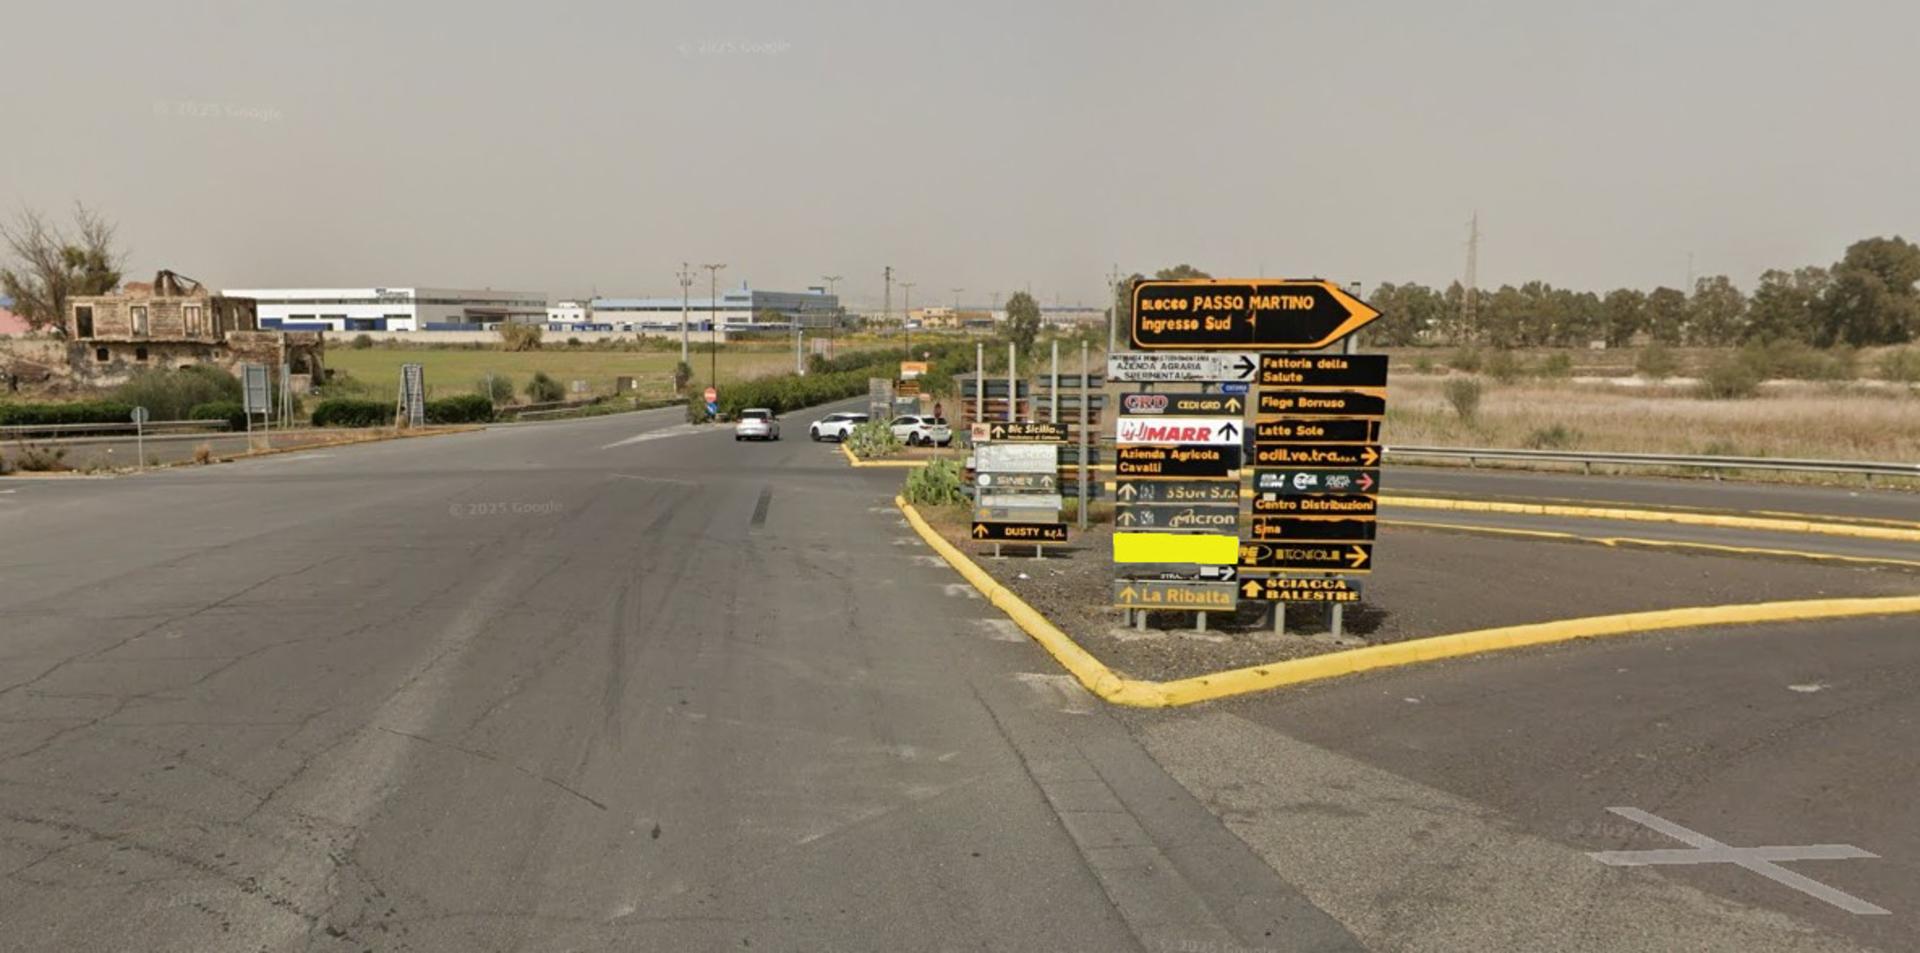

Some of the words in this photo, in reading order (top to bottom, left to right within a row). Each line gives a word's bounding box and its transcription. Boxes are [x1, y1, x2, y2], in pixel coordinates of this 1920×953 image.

[1193, 296, 1243, 311] PASSO
[1250, 296, 1315, 310] MARTINO
[1142, 315, 1199, 334] ingresso
[1205, 315, 1231, 330] Sud
[1117, 362, 1156, 370] AZIENDA
[1161, 362, 1201, 370] AGRARIA
[1263, 358, 1312, 369] Fattoria
[1317, 358, 1348, 369] della
[1263, 372, 1303, 382] Salute
[1147, 427, 1212, 441] MARR
[1259, 426, 1291, 436] Latte
[1296, 426, 1324, 436] Sole
[1120, 450, 1165, 459] Azienda
[1171, 450, 1219, 461] Agricola
[1120, 462, 1161, 472] Cavalli
[1255, 500, 1296, 510] Centro
[1301, 500, 1374, 510] Distribuzioni
[1005, 527, 1039, 536] DUSTY
[1266, 579, 1346, 589] SCIACCA
[1143, 589, 1161, 602] La
[1167, 589, 1230, 604] Ribalta
[1266, 590, 1360, 600] BALESTRE
